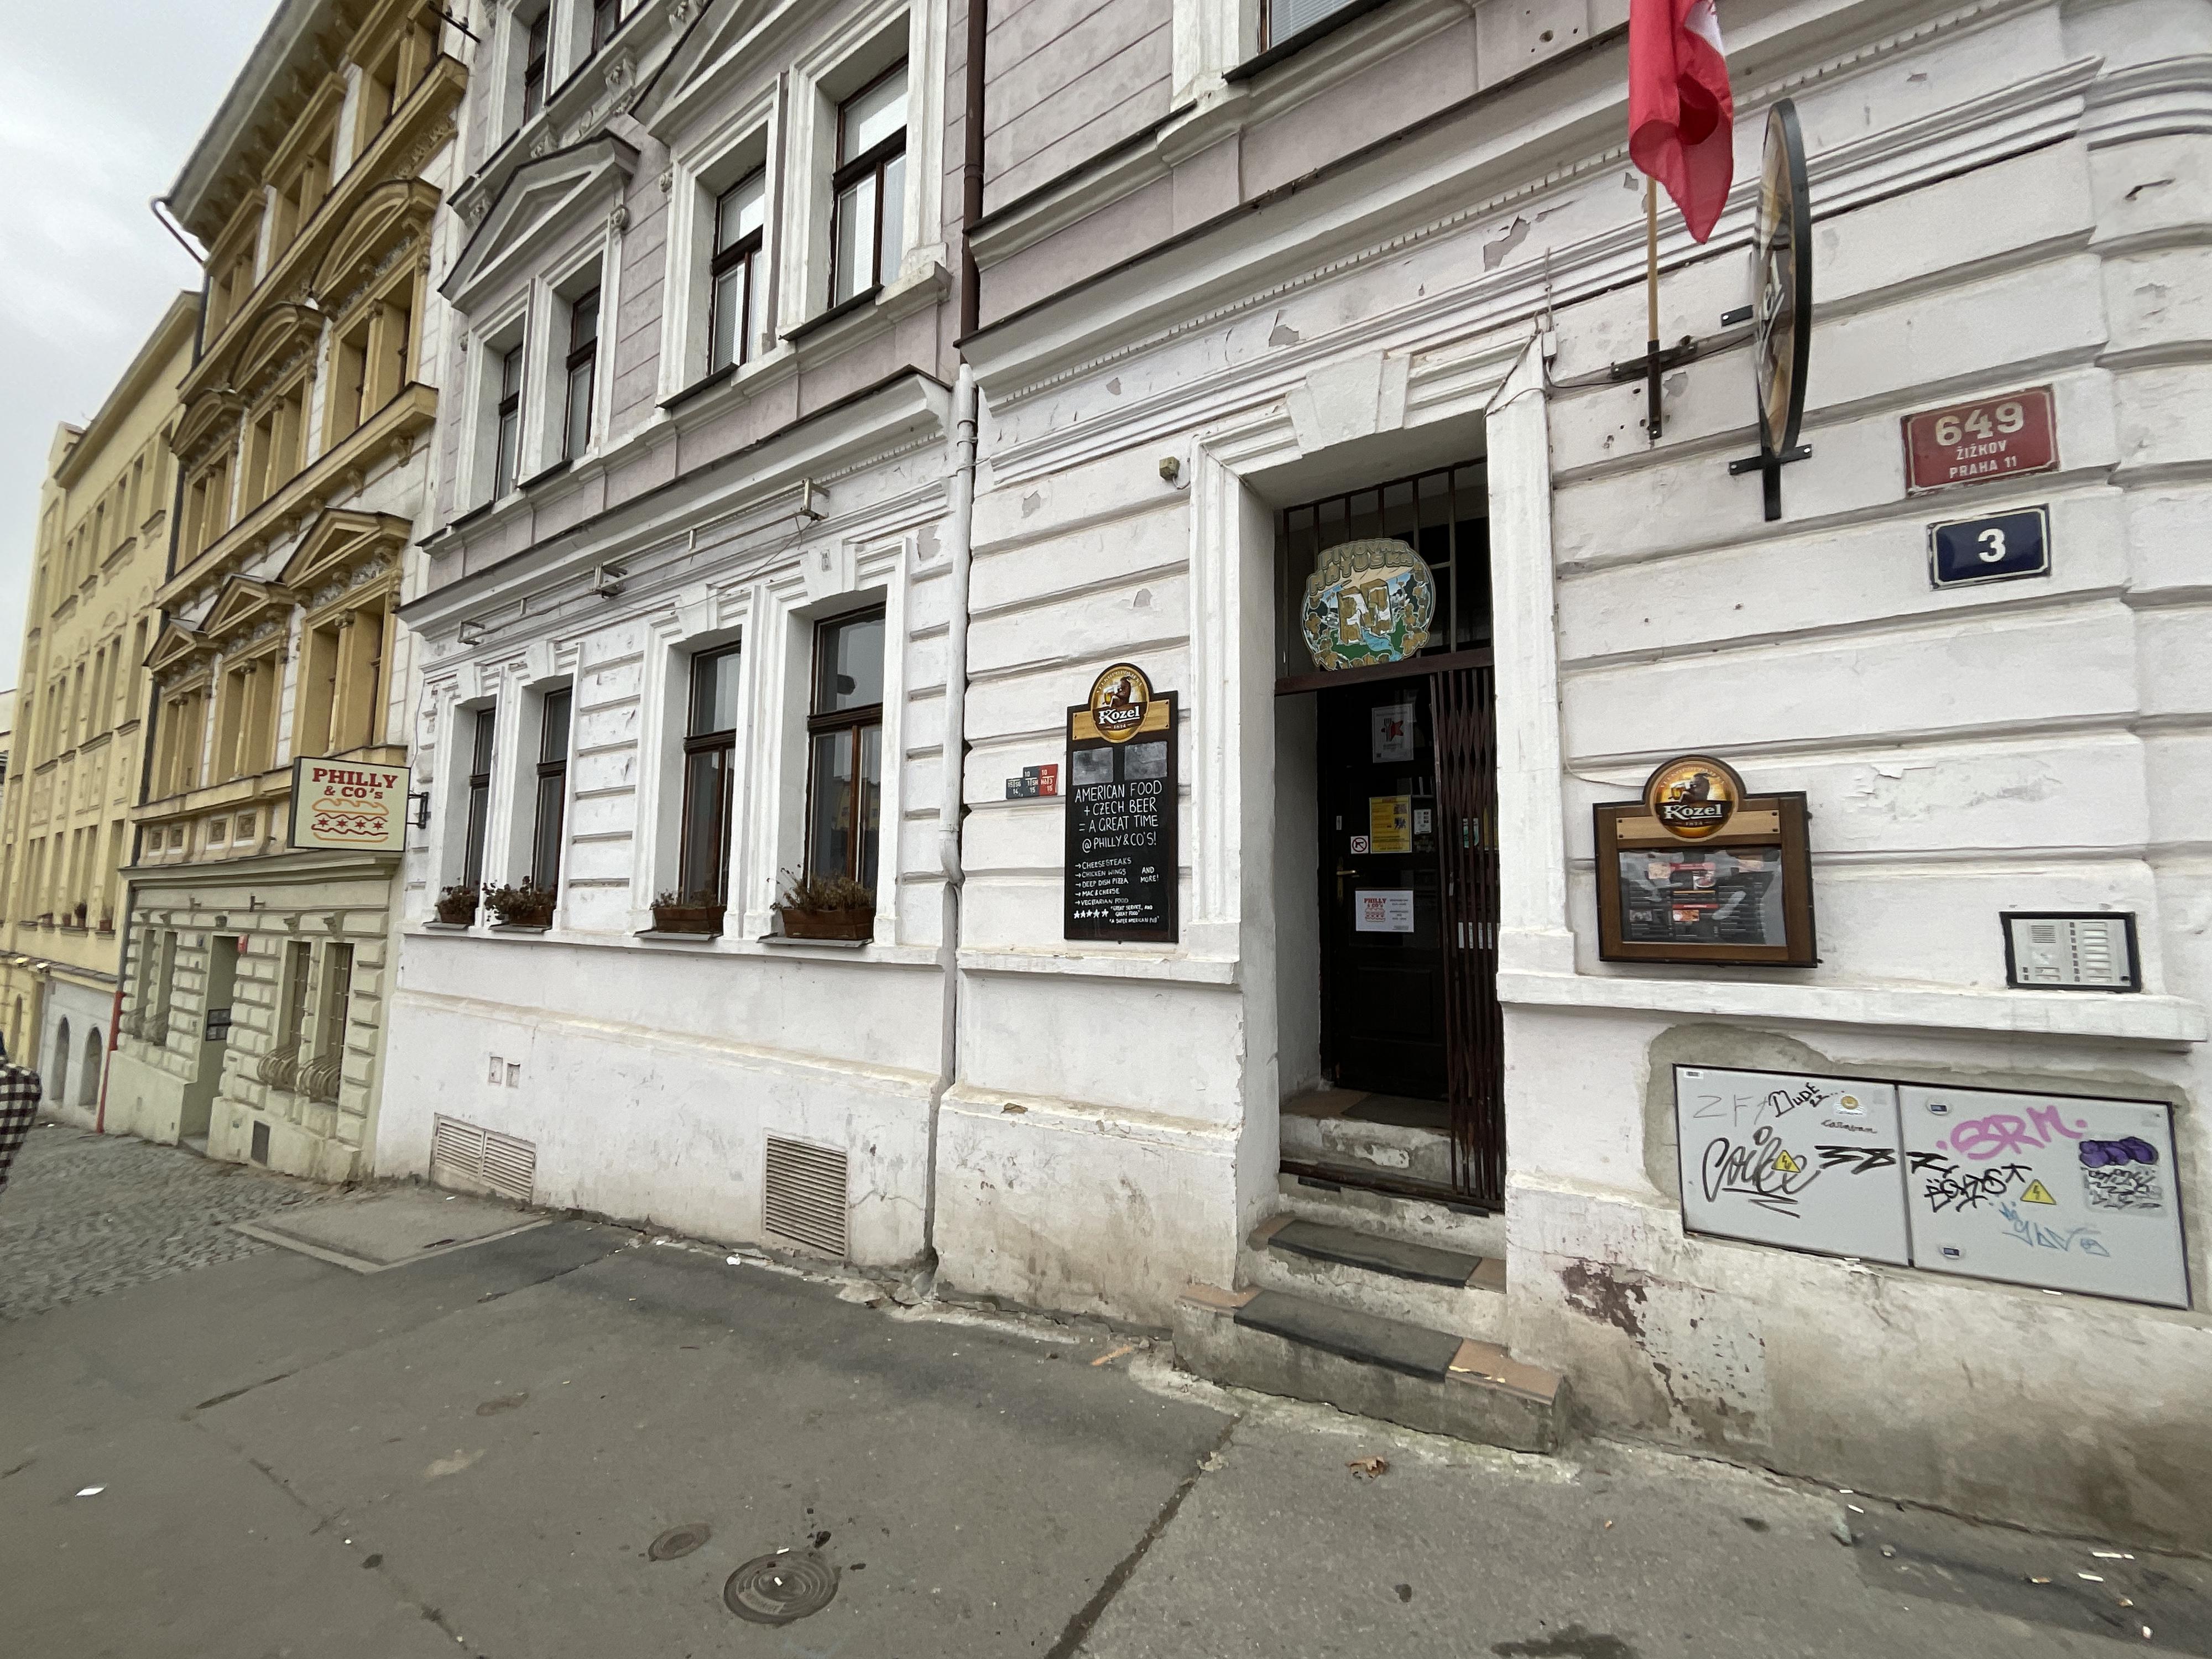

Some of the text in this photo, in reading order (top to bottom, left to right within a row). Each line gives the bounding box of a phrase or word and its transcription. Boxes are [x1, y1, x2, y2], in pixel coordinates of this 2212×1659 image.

[1936, 401, 2024, 446] 649
[1957, 440, 2007, 461] ŽIŽKOV
[1949, 455, 2017, 479] PRAHA 11
[1978, 528, 2006, 562] 3
[1098, 706, 1140, 724] Kozel
[312, 768, 398, 789] PHILLY
[324, 786, 336, 796] &
[1075, 780, 1162, 802] AMERICAN FOOD
[1093, 801, 1124, 815] CZECH
[1129, 797, 1157, 813] BEER
[1663, 804, 1723, 820] Kozel
[1089, 820, 1096, 833] A
[1098, 816, 1129, 831] GREAT
[1134, 815, 1159, 827] TIME
[1082, 857, 1132, 869] CHEESESTEAKS
[1140, 874, 1159, 883] MORE!
